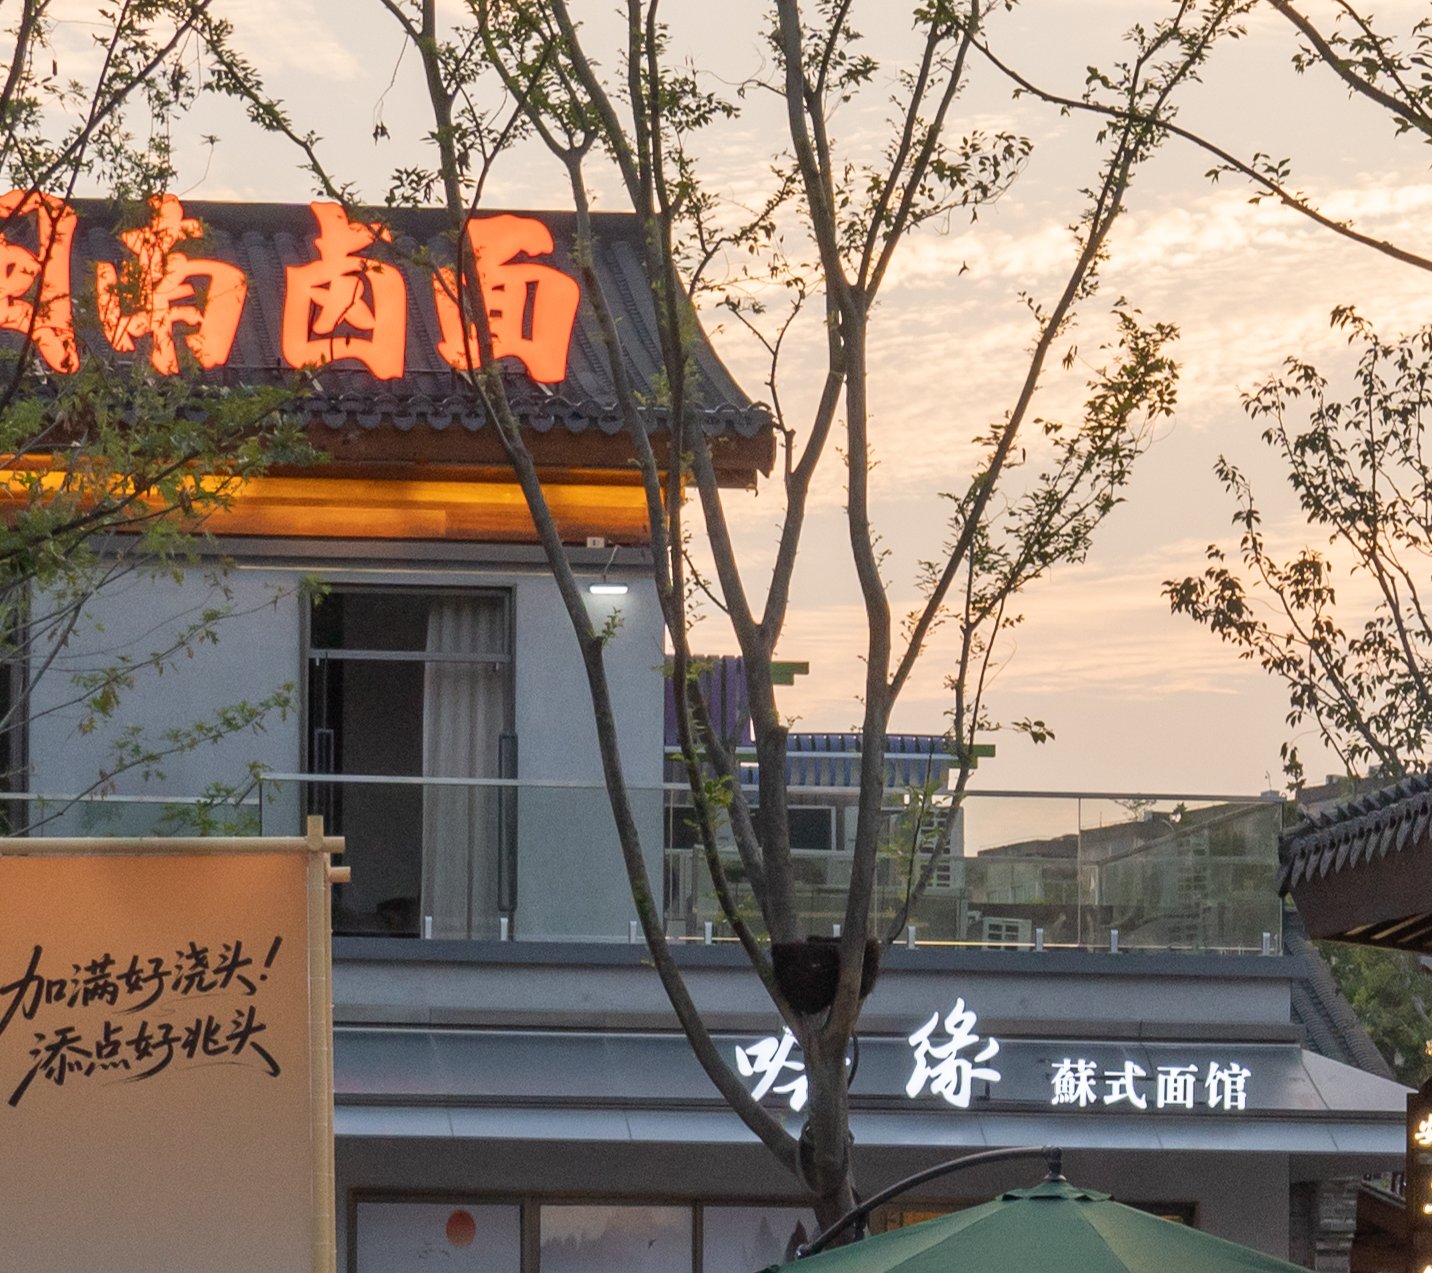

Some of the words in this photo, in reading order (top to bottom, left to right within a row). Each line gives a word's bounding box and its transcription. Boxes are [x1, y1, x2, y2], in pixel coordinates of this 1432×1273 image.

[8, 1006, 281, 1107] 添点好兆头
[1051, 1058, 1252, 1110] 蘇式面馆
